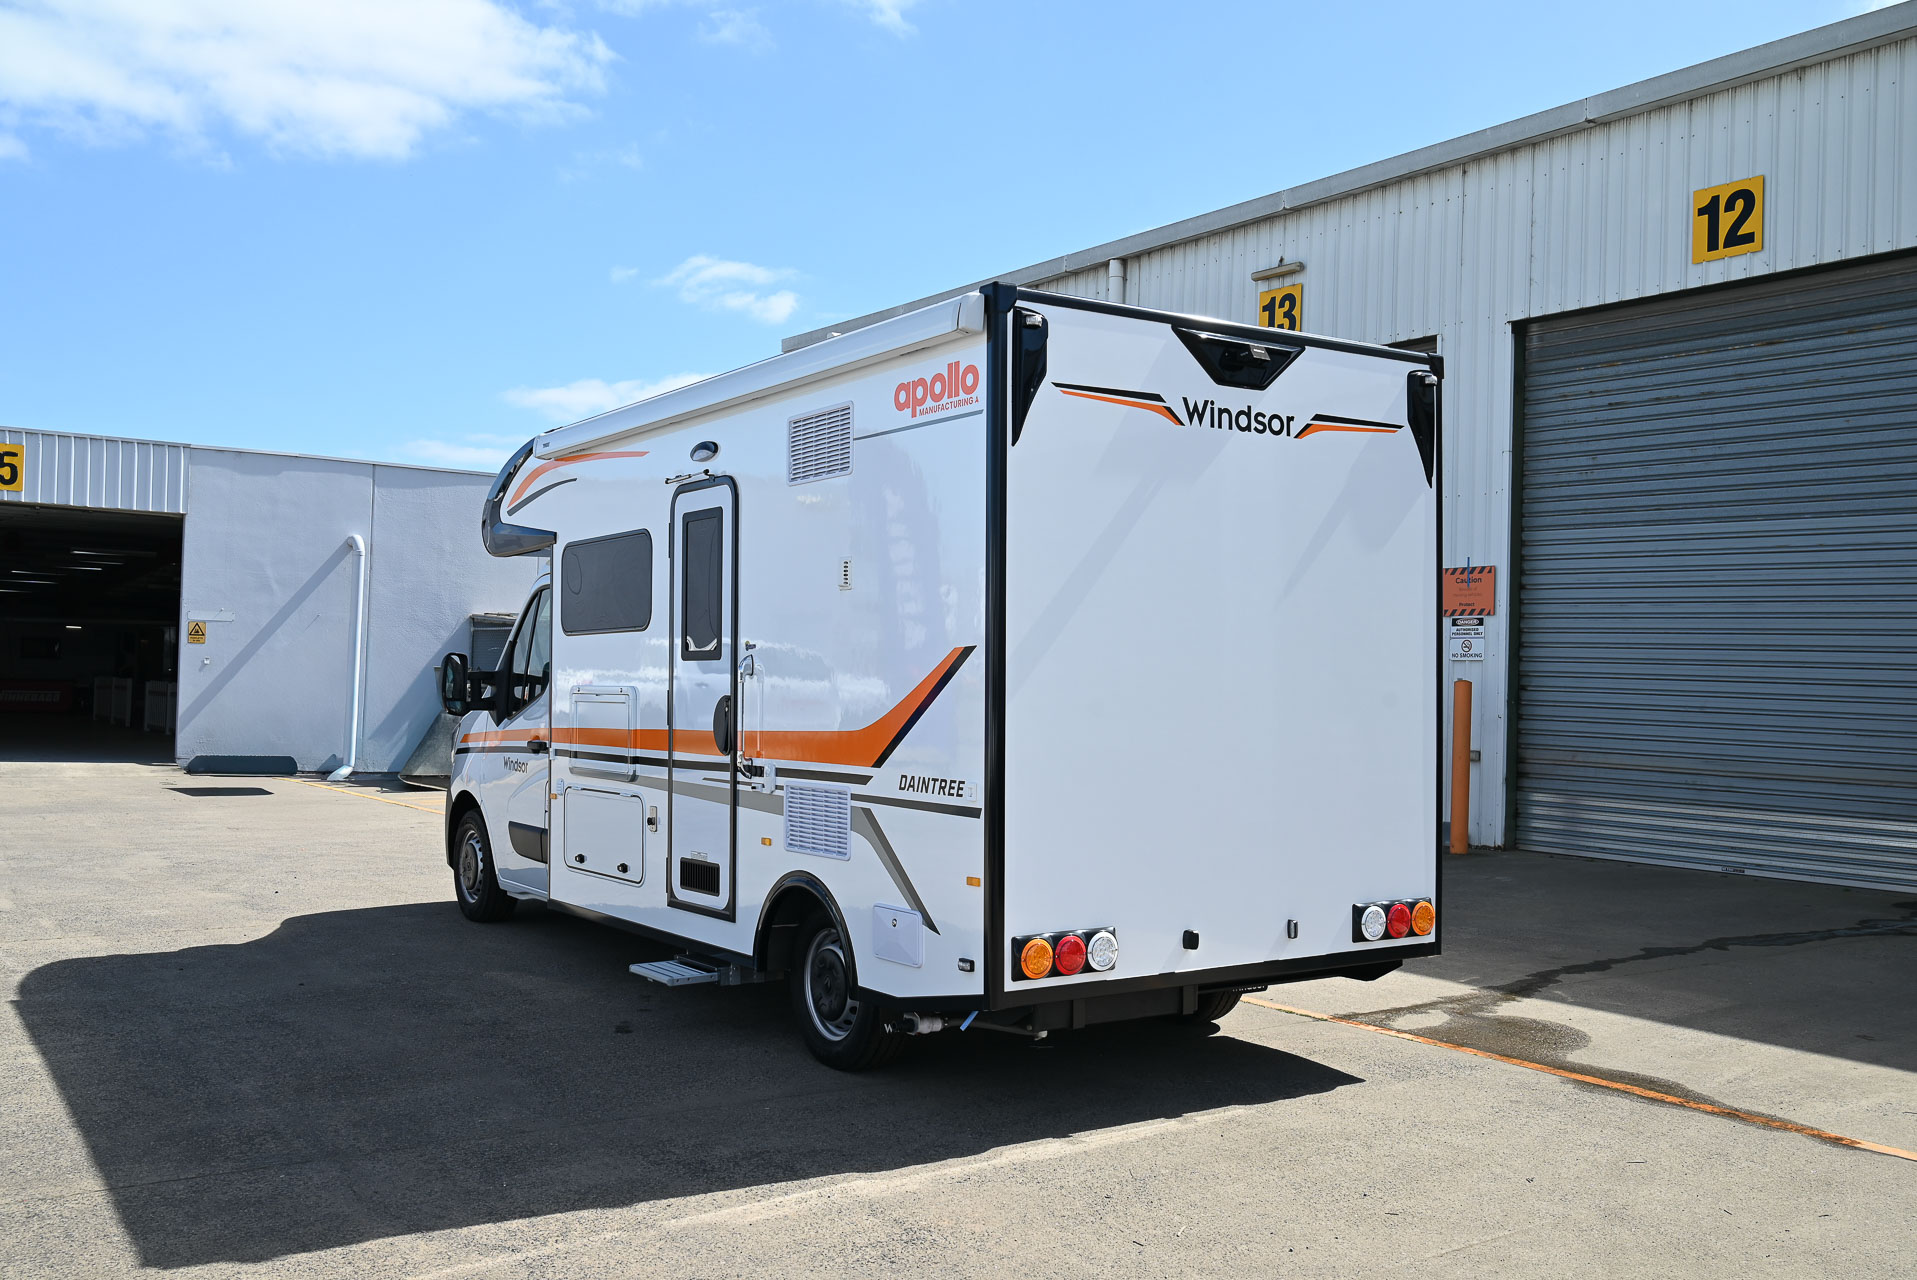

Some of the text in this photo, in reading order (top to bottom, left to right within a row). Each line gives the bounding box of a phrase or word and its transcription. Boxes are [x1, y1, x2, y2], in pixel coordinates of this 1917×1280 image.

[1697, 188, 1756, 252] 12
[1262, 292, 1297, 331] 13
[894, 361, 979, 418] apollo
[919, 397, 974, 416] MANUFACTURING
[1182, 396, 1295, 437] Windsor
[0, 451, 19, 485] 5
[503, 756, 528, 773] Windsor
[899, 775, 965, 797] DAINTREE
